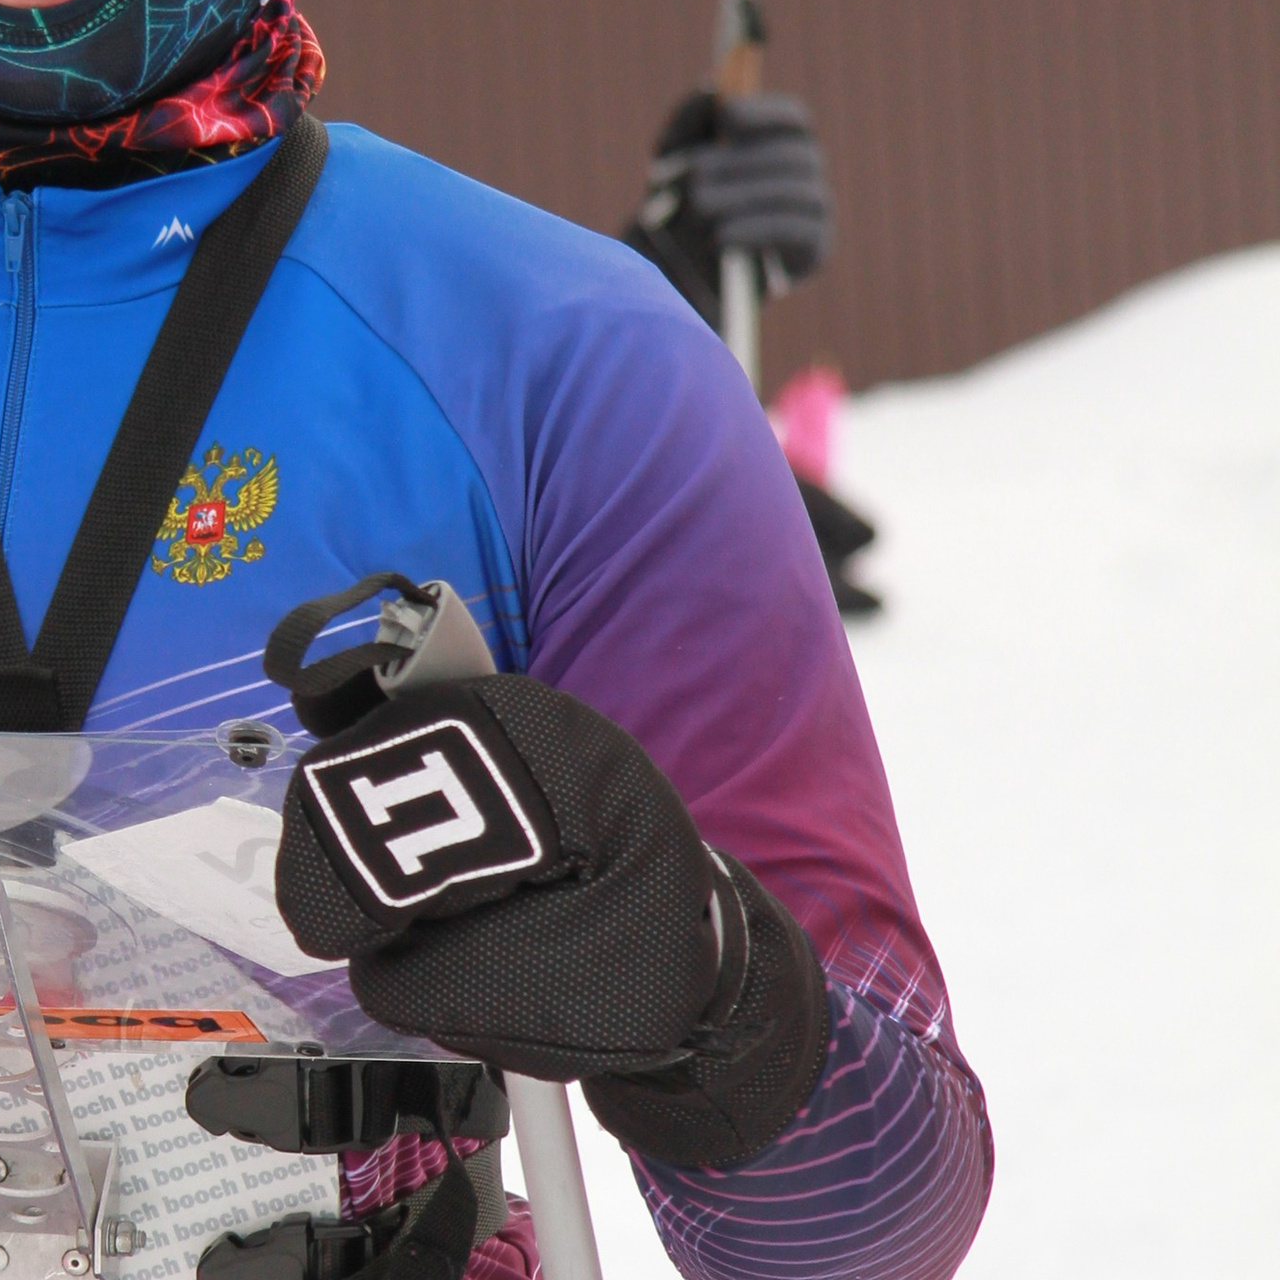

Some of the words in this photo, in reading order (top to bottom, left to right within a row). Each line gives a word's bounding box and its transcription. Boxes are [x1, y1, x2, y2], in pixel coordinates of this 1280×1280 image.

[73, 1095, 117, 1119] och
[131, 1105, 188, 1131] booc
[152, 1151, 228, 1186] booch
[162, 1178, 239, 1214] booch
[241, 1154, 317, 1189] booch
[173, 1206, 249, 1241] booch
[252, 1182, 327, 1218] booch
